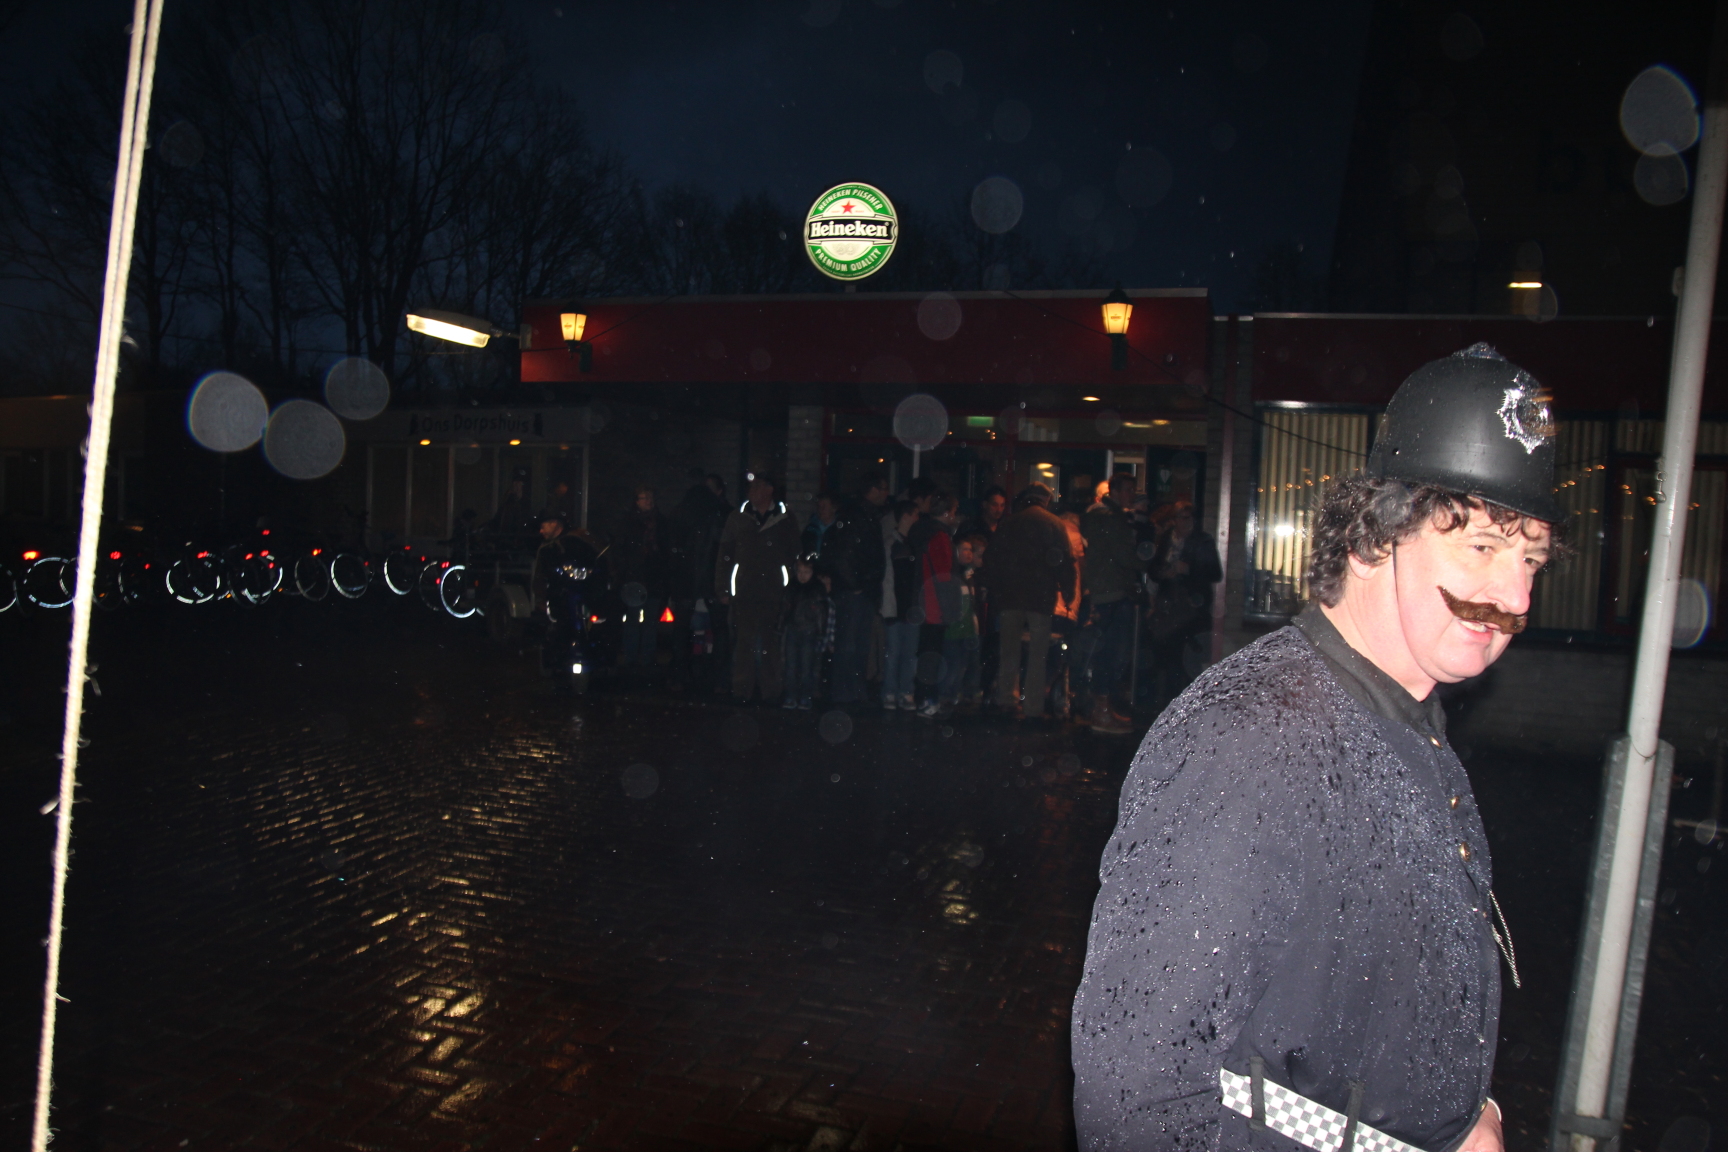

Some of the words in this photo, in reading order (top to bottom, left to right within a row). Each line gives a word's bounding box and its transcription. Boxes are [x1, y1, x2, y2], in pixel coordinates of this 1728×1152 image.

[818, 189, 851, 211] HEINEKEN
[852, 189, 883, 210] PILSENER
[811, 220, 888, 238] Heineken
[815, 248, 848, 271] PREMIUM
[850, 248, 882, 271] QUALITY
[422, 417, 450, 433] Ons
[453, 412, 529, 434] Dorpshuis
